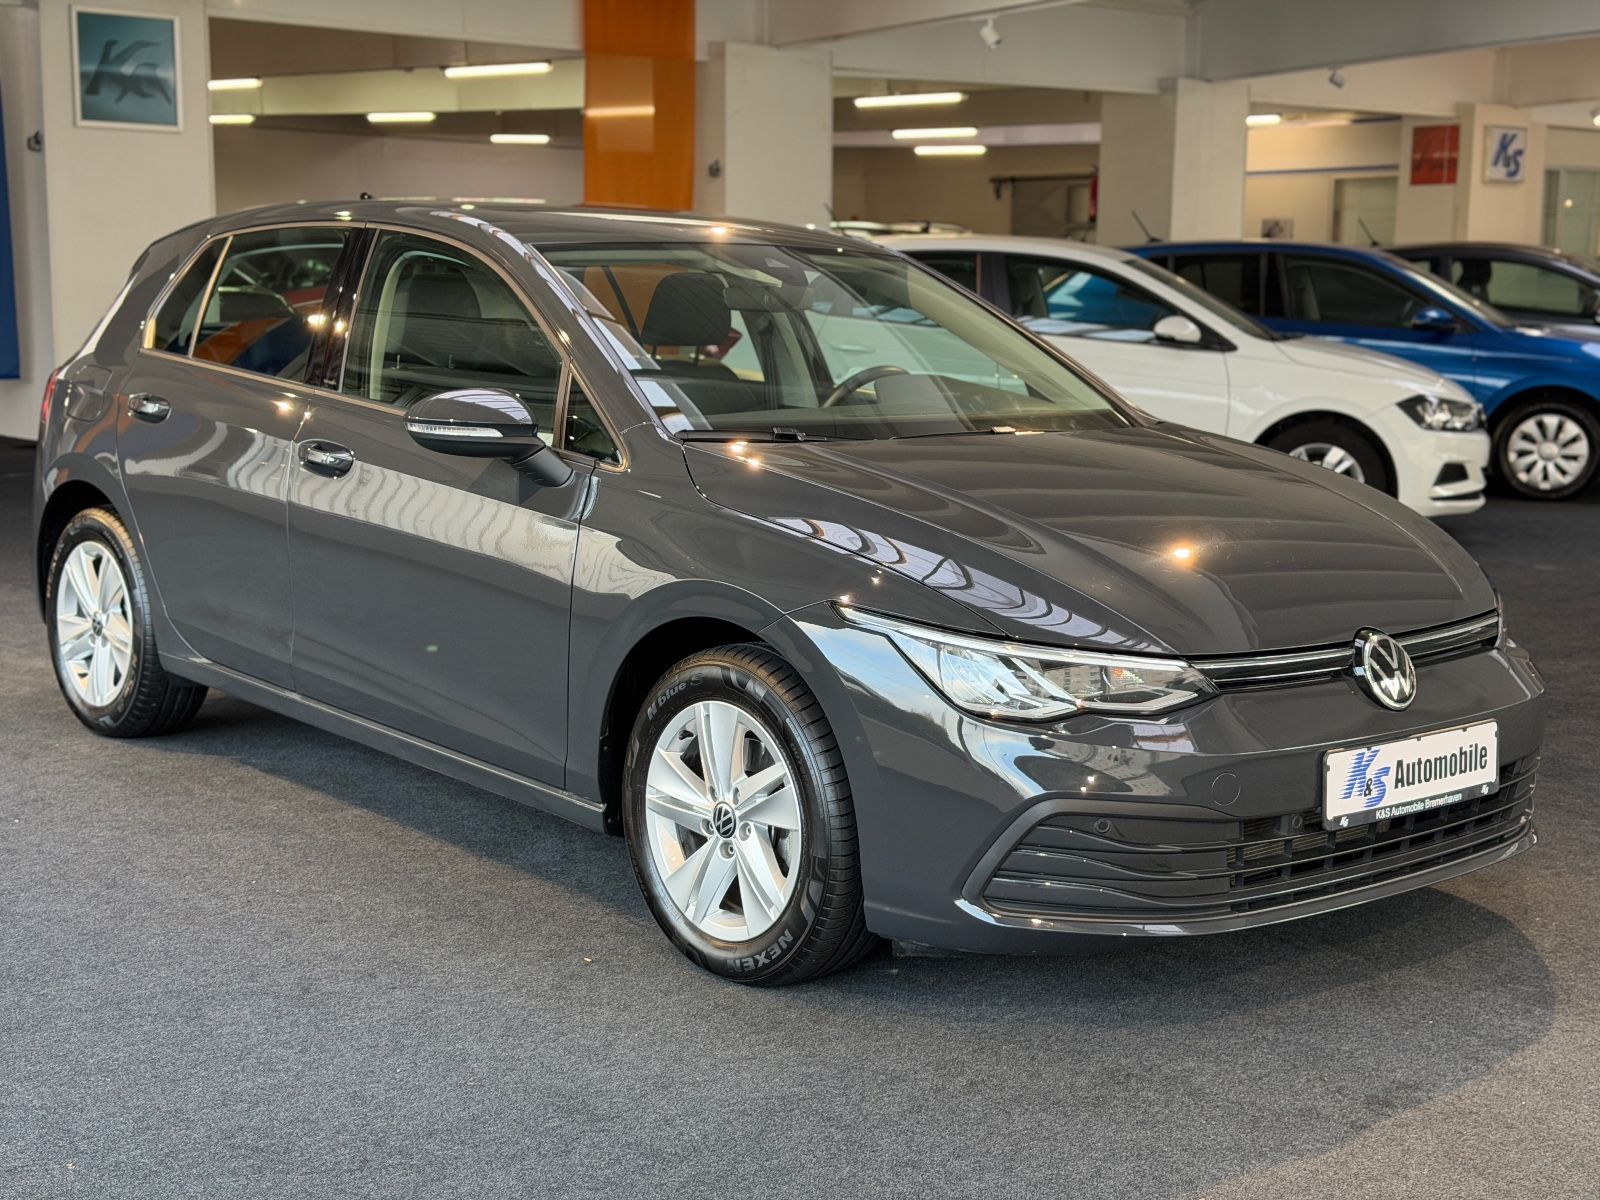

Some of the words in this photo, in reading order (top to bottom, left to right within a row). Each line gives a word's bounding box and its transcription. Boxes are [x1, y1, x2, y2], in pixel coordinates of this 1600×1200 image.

[658, 682, 687, 707] blue
[1339, 748, 1391, 808] K&S
[1394, 743, 1488, 789] Automobile
[1375, 808, 1391, 819] K&S
[1391, 801, 1424, 817] Automobile
[1425, 793, 1463, 808] Bremerhaven
[726, 929, 794, 972] NEXEN
